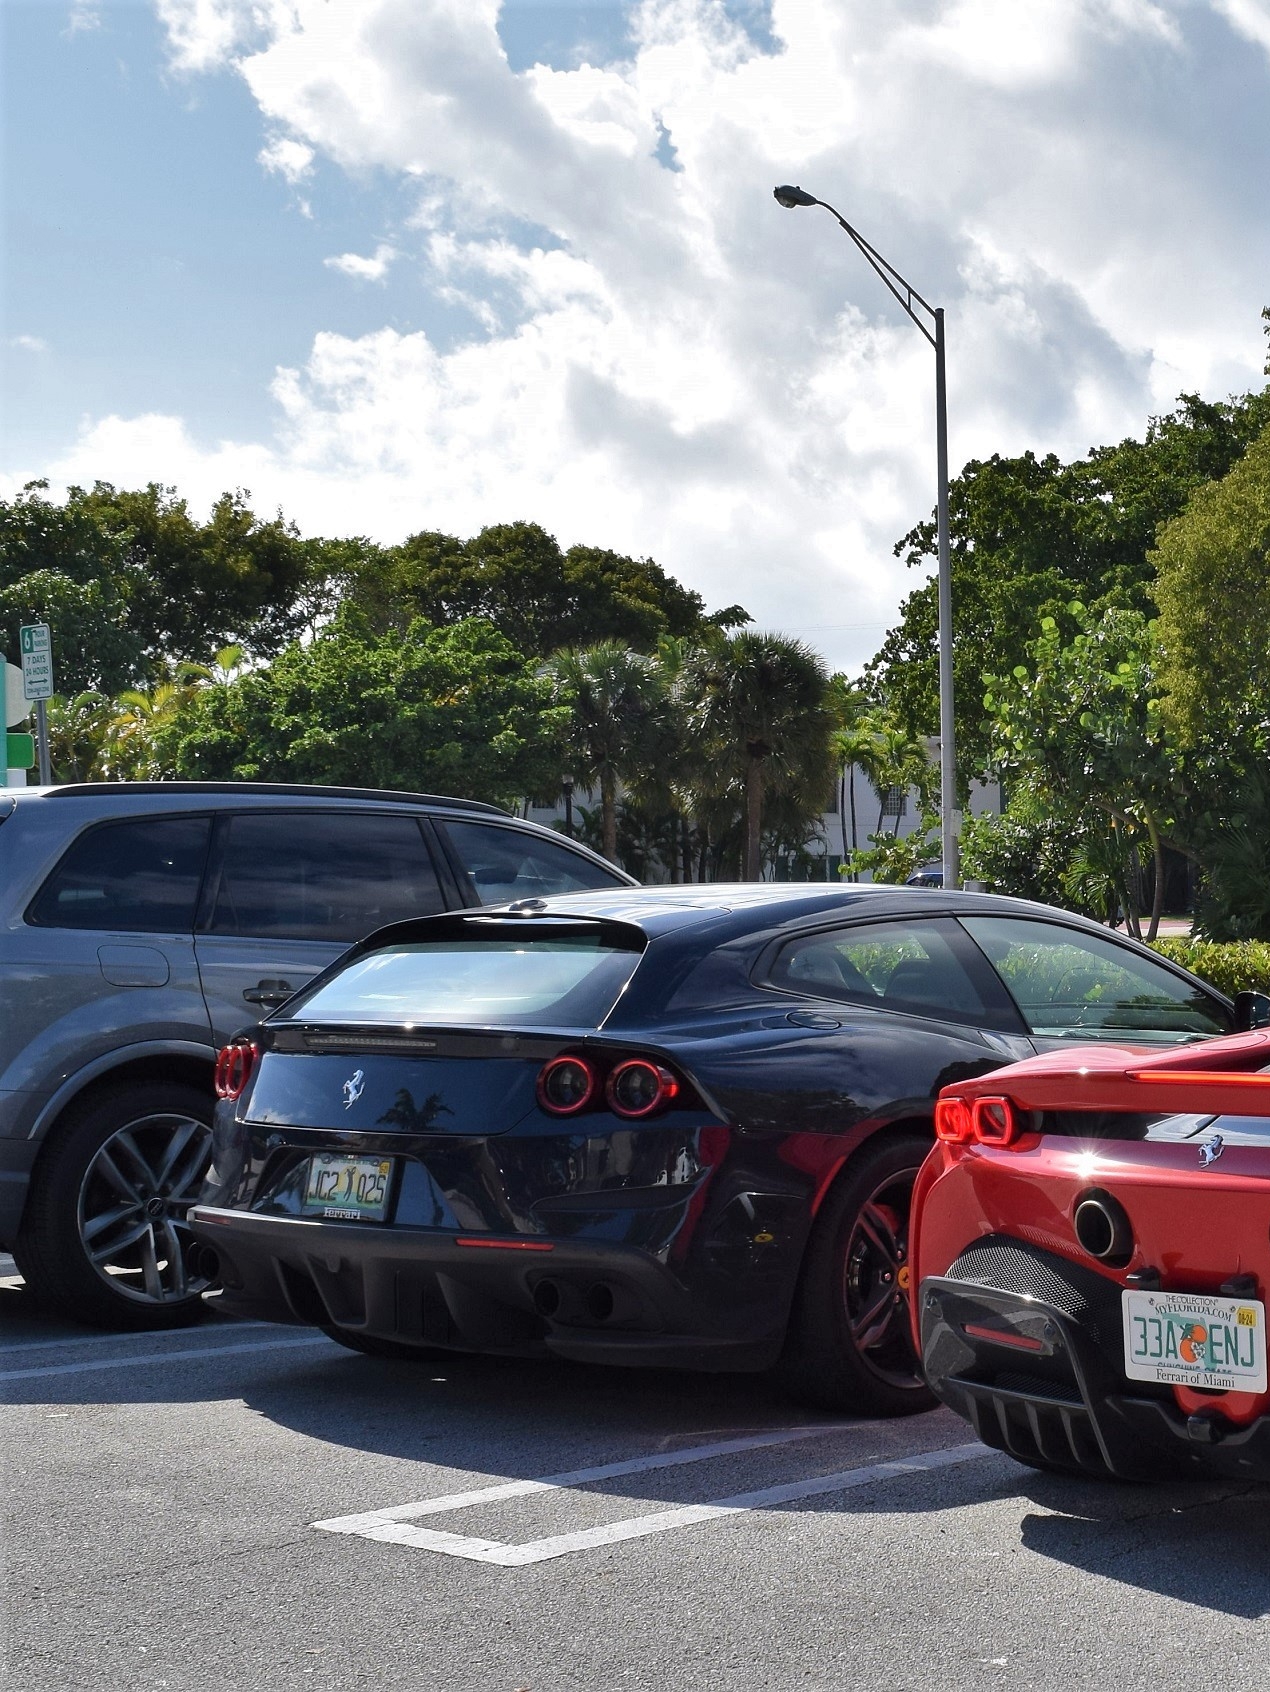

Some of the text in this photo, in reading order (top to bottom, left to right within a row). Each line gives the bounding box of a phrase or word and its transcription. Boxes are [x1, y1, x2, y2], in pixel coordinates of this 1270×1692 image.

[24, 631, 31, 650] 6
[27, 655, 46, 665] 7 DAYS
[26, 666, 49, 676] 24 HOURS
[323, 1207, 360, 1219] Ferrari
[1155, 1303, 1232, 1322] MYFLORIDA.COM
[1133, 1316, 1254, 1368] 33A ENJ
[1156, 1368, 1235, 1388] Ferrari of Miami
